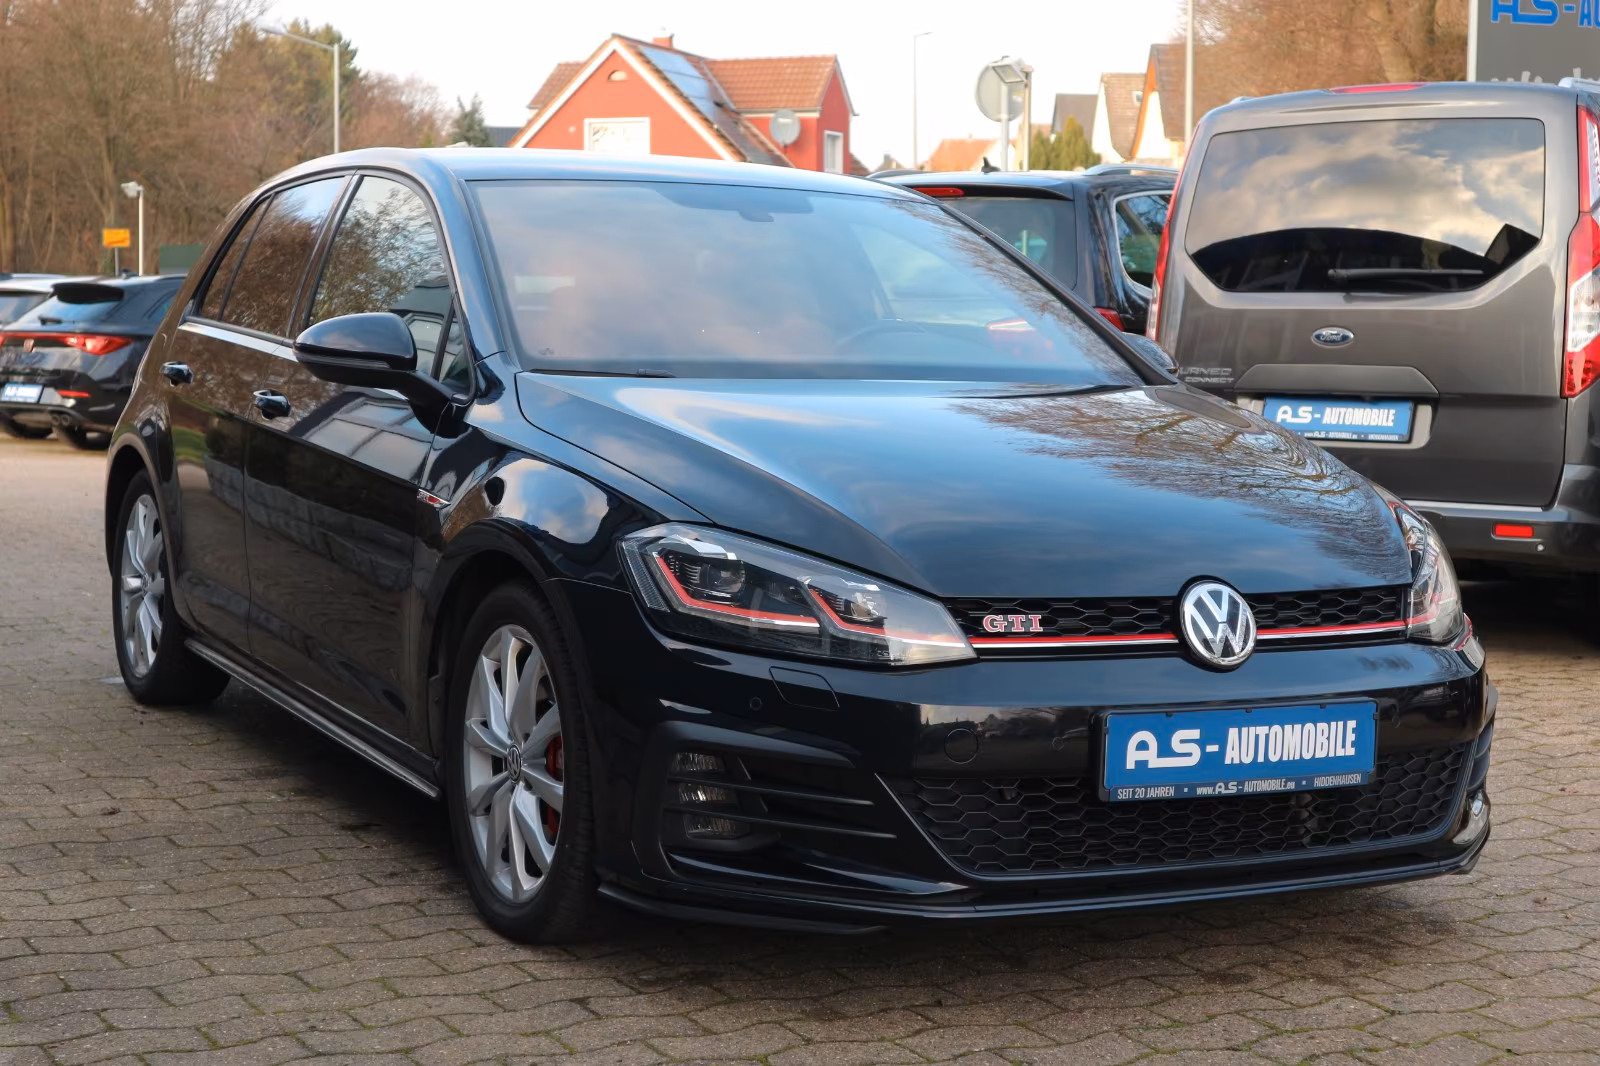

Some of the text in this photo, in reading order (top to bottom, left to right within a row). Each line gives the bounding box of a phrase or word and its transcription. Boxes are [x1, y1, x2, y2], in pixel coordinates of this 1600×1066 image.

[982, 614, 1044, 632] GTI
[1117, 788, 1134, 799] SEIT
[1134, 787, 1145, 799] 20
[1146, 786, 1175, 798] JAHREN
[1313, 773, 1362, 787] HIDDENHAUSEN
